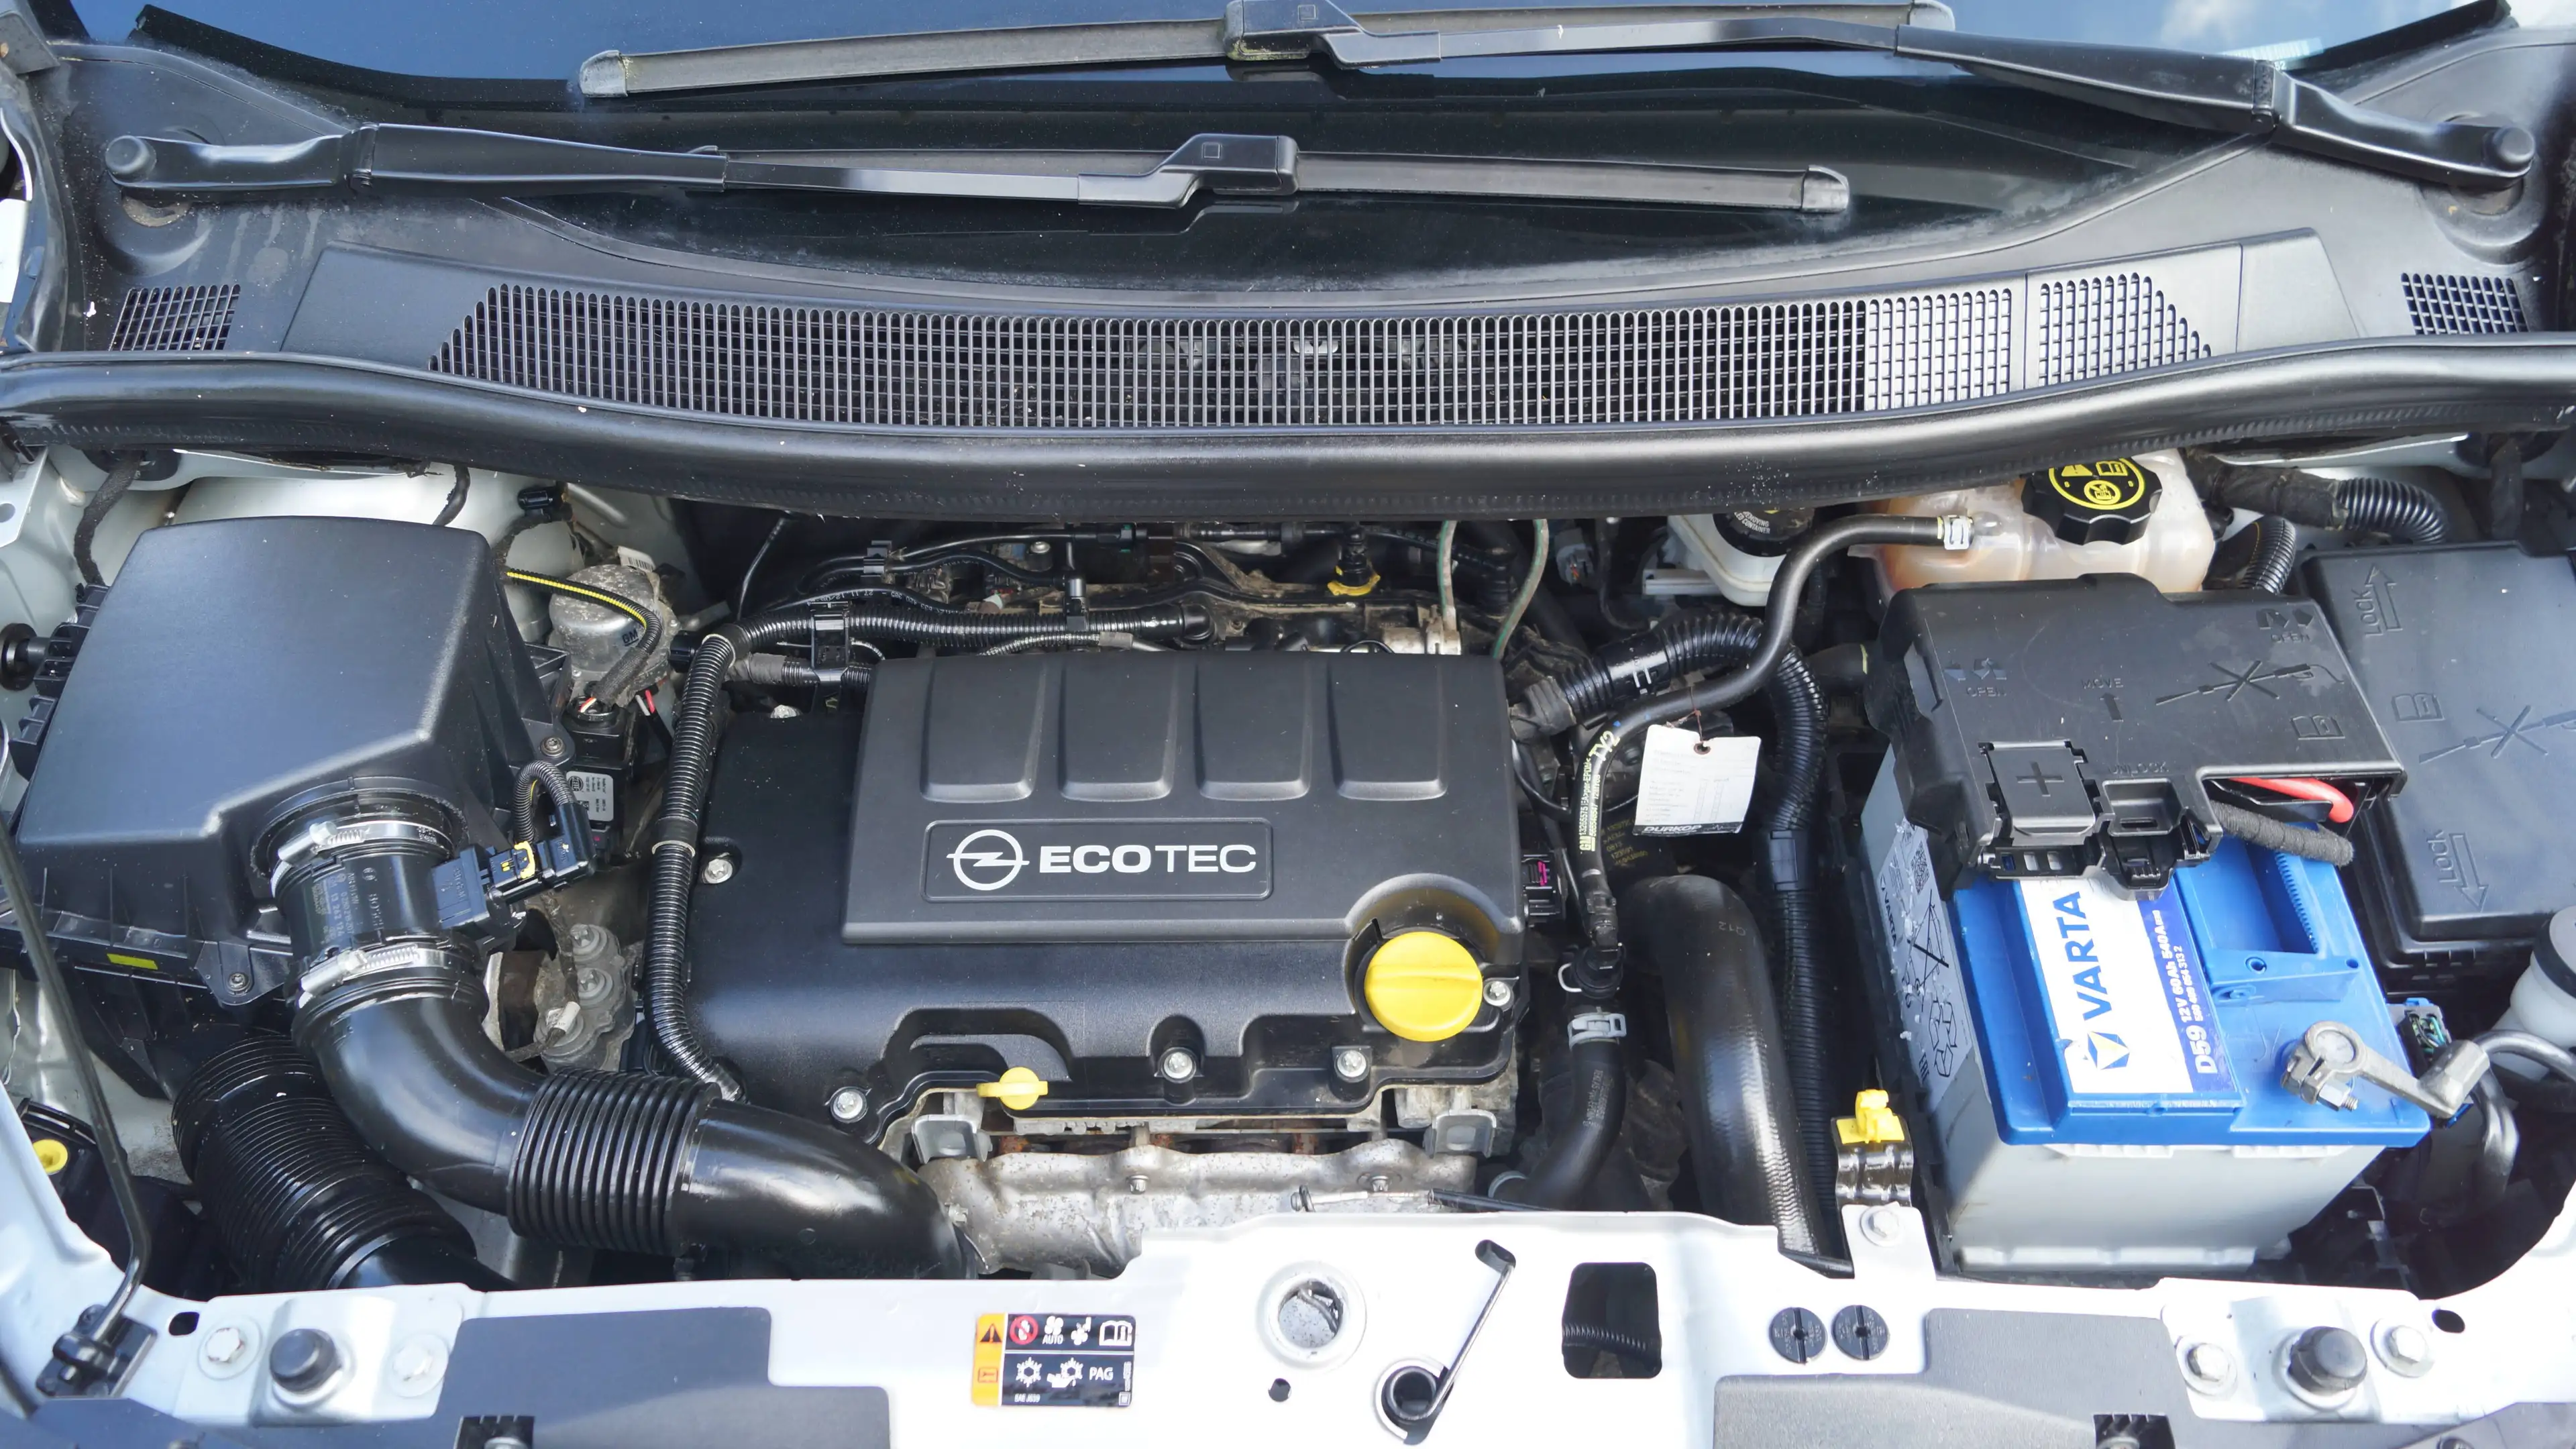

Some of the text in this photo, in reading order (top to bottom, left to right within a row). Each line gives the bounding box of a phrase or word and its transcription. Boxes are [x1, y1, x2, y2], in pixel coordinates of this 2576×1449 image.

[2351, 588, 2383, 637] LOCK
[1966, 686, 2007, 697] OPEN
[2082, 678, 2124, 689] MOVE
[1589, 731, 1620, 761] TY2
[2108, 762, 2170, 774] UNLOCK
[1040, 845, 1256, 873] ECOTEC
[2426, 829, 2458, 883] LOCK
[2053, 891, 2112, 1021] VARTA
[2175, 997, 2192, 1022] 12V
[2186, 1025, 2218, 1074] D59
[1042, 1335, 1063, 1344] AUTO
[1089, 1366, 1114, 1381] PAG
